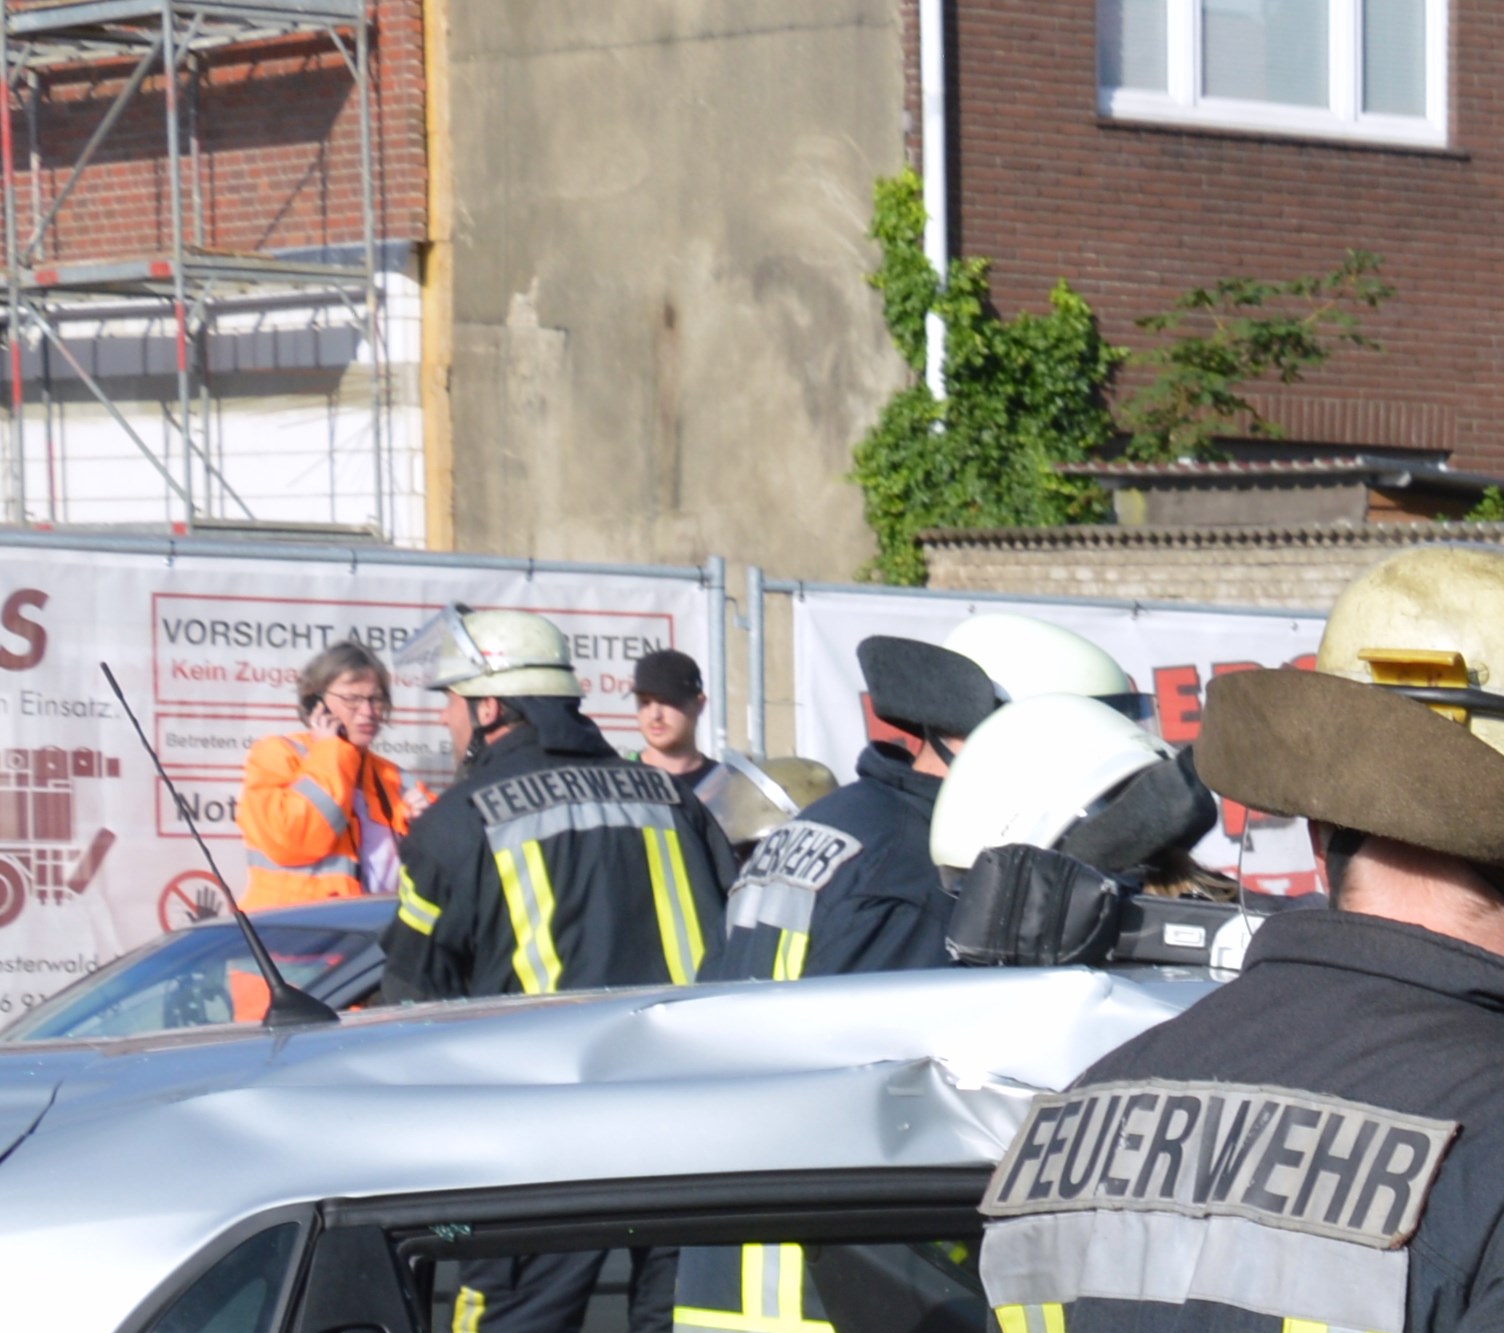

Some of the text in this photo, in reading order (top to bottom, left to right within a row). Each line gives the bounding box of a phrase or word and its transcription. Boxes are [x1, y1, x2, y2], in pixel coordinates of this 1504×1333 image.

[162, 618, 334, 649] VORSICHT
[171, 658, 227, 682] Kein
[20, 690, 122, 720] Einsatz.
[165, 733, 242, 750] Betreten
[484, 769, 675, 824] FEUERWEHR
[996, 1092, 1432, 1237] FEUERWEHR
